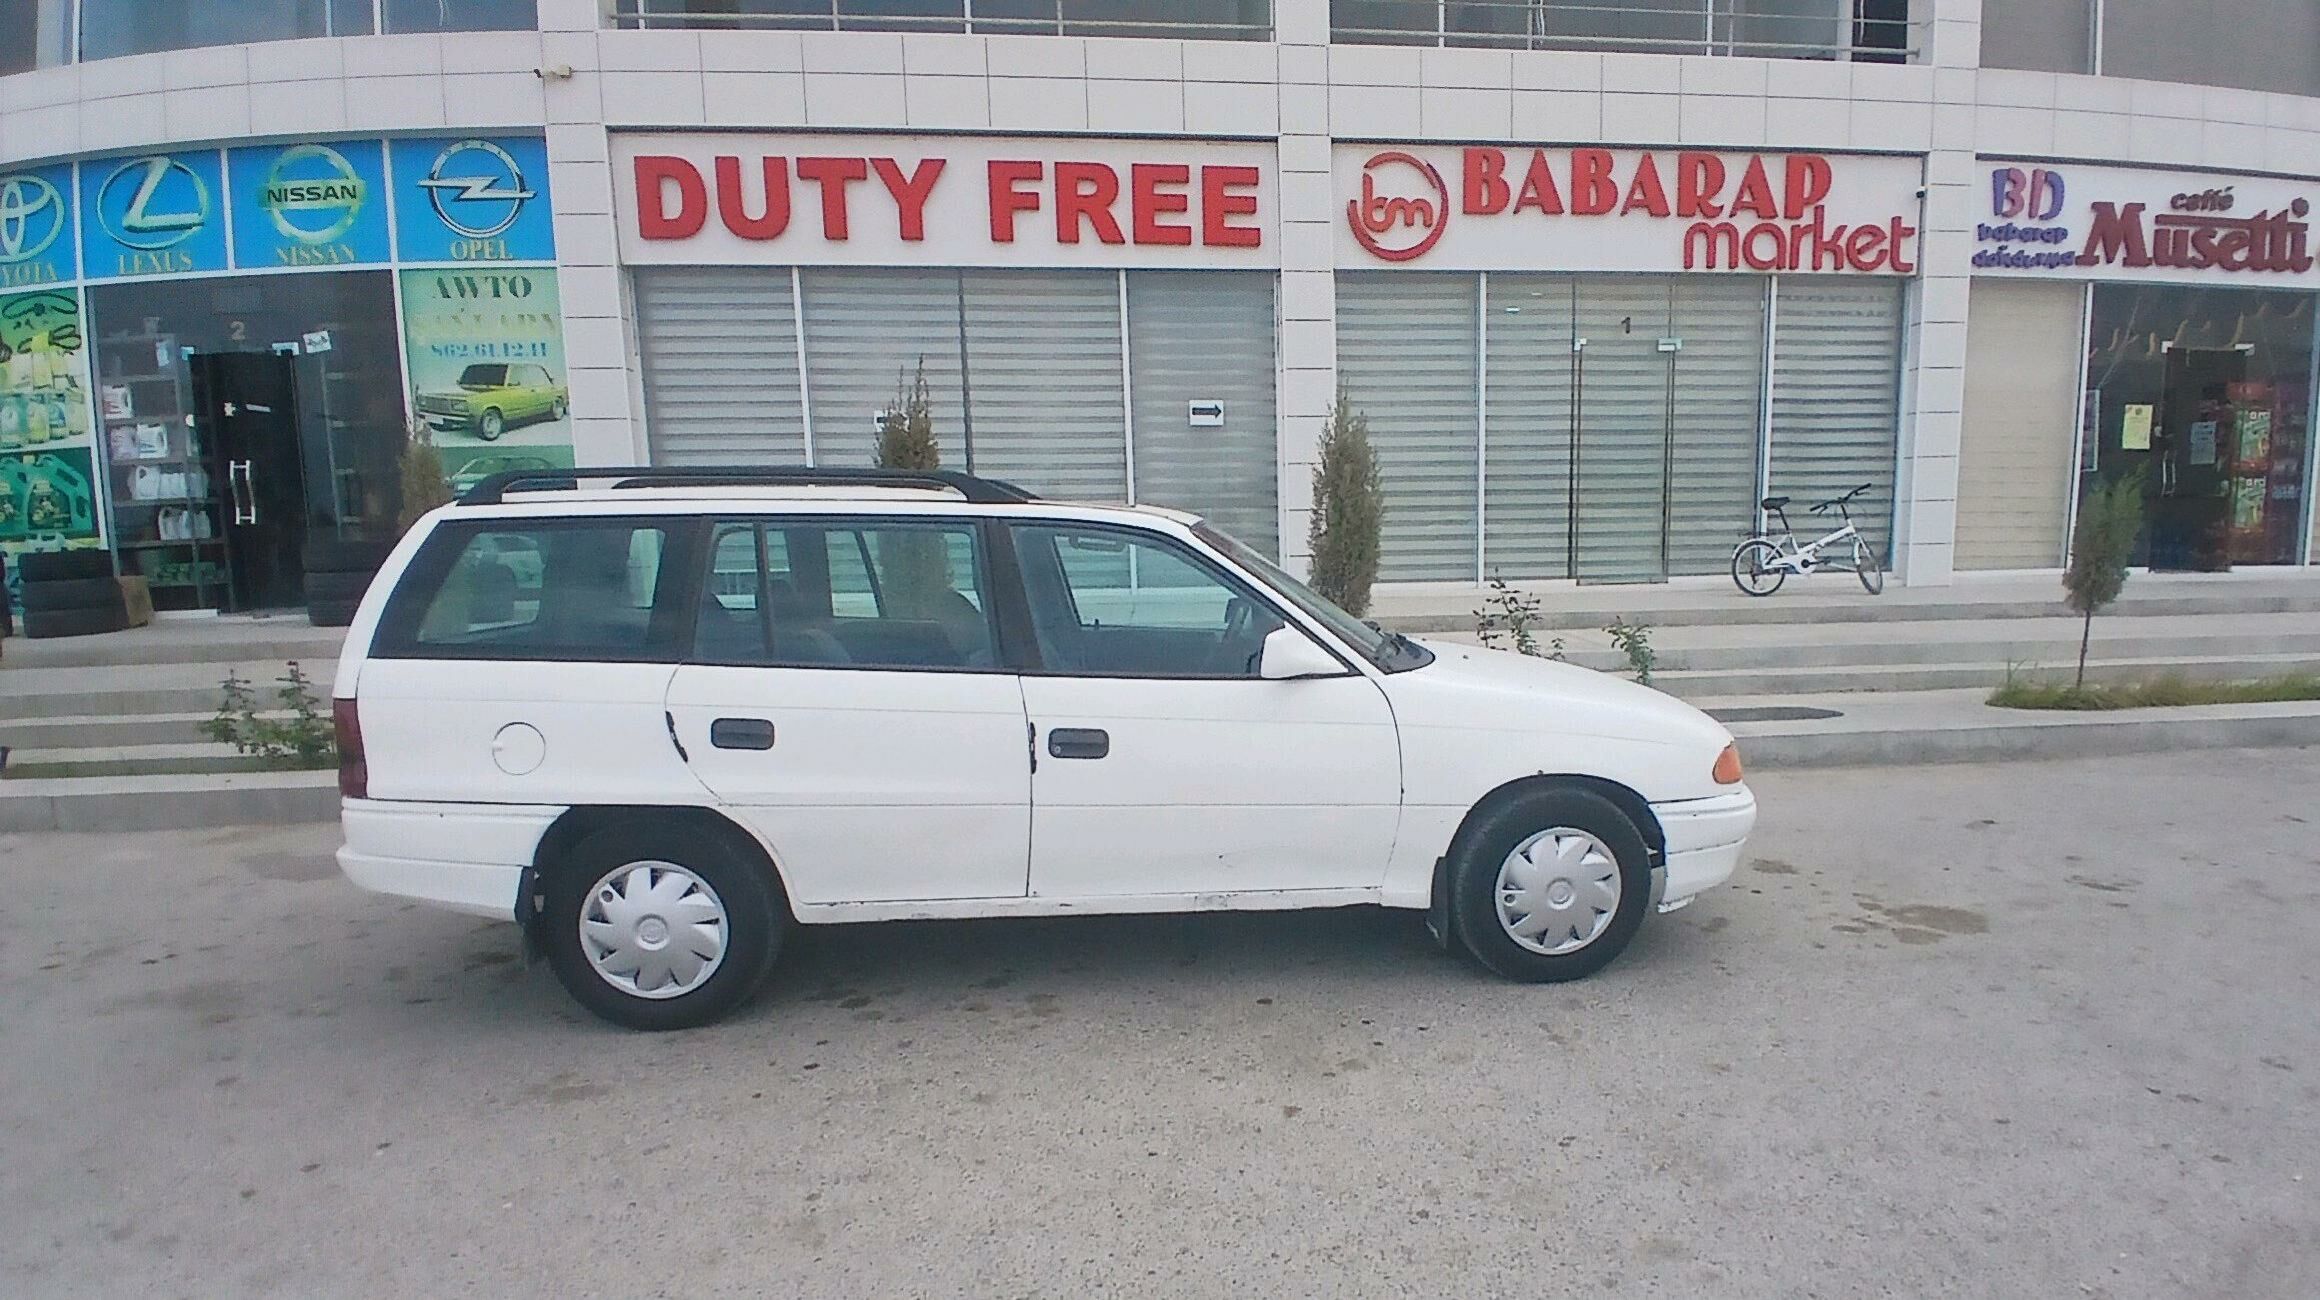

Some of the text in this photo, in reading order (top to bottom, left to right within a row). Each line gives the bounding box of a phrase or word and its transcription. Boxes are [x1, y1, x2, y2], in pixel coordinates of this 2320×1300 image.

[267, 184, 357, 203] NISSAN
[1462, 147, 1832, 220] BABARAP
[1992, 167, 2065, 220] BD
[633, 156, 1262, 247] DUTY FREE
[1683, 206, 1916, 272] market
[2075, 197, 2314, 273] Musetti
[275, 243, 356, 266] NISSAN
[450, 239, 513, 260] OPEL
[432, 275, 533, 299] AWTO
[229, 321, 246, 341] 2
[1621, 316, 1631, 334] 1
